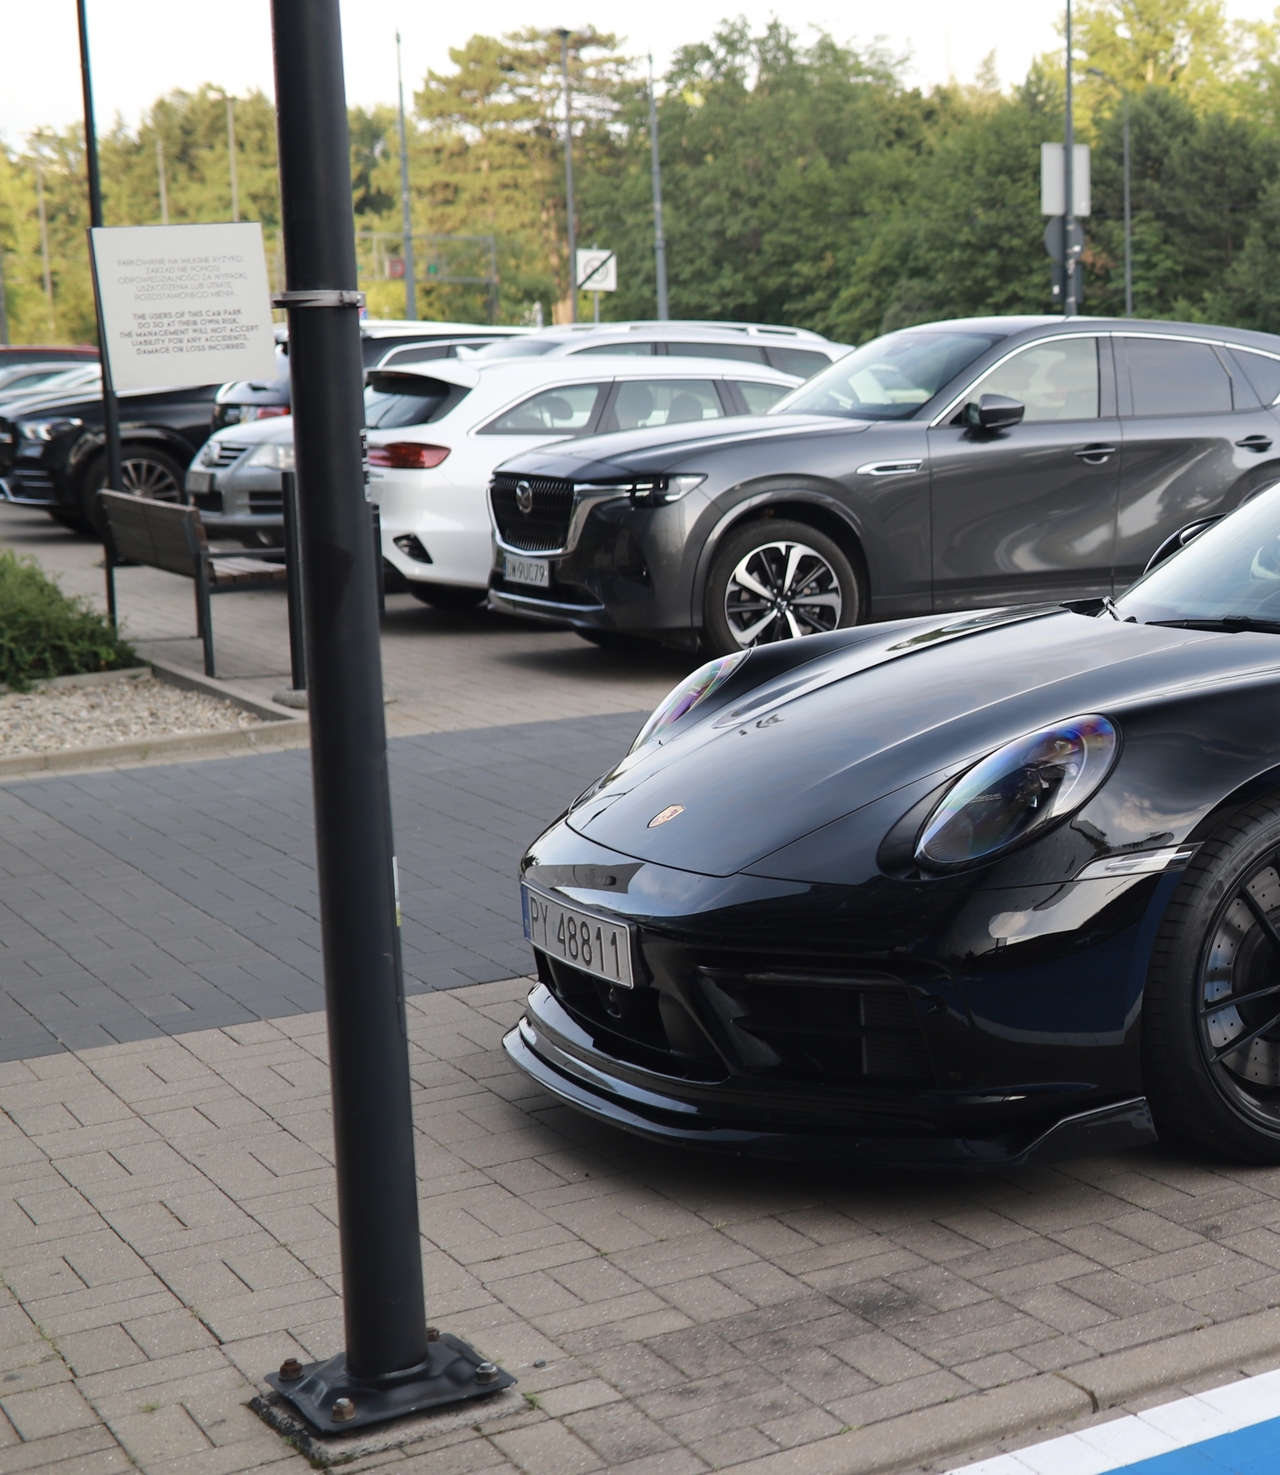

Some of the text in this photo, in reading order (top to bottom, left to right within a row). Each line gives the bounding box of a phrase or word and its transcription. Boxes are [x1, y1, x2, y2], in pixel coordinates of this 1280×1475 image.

[167, 257, 179, 266] NA
[190, 282, 205, 290] LUB
[132, 313, 147, 321] THE
[148, 312, 173, 320] USERS
[204, 310, 221, 318] CAR
[222, 309, 242, 317] PARK
[137, 322, 151, 330] DO
[152, 321, 165, 329] SO
[166, 320, 176, 328] AT
[177, 319, 199, 327] THEIR
[200, 318, 220, 326] OWN
[119, 325, 259, 340] THE MANAGEMENT WILL NOT ACCEPT
[131, 339, 167, 347] LIABILITY
[136, 347, 171, 356] DAMAGE
[171, 346, 185, 354] OR
[185, 345, 206, 353] LOSS
[530, 895, 621, 981] PY 48811
